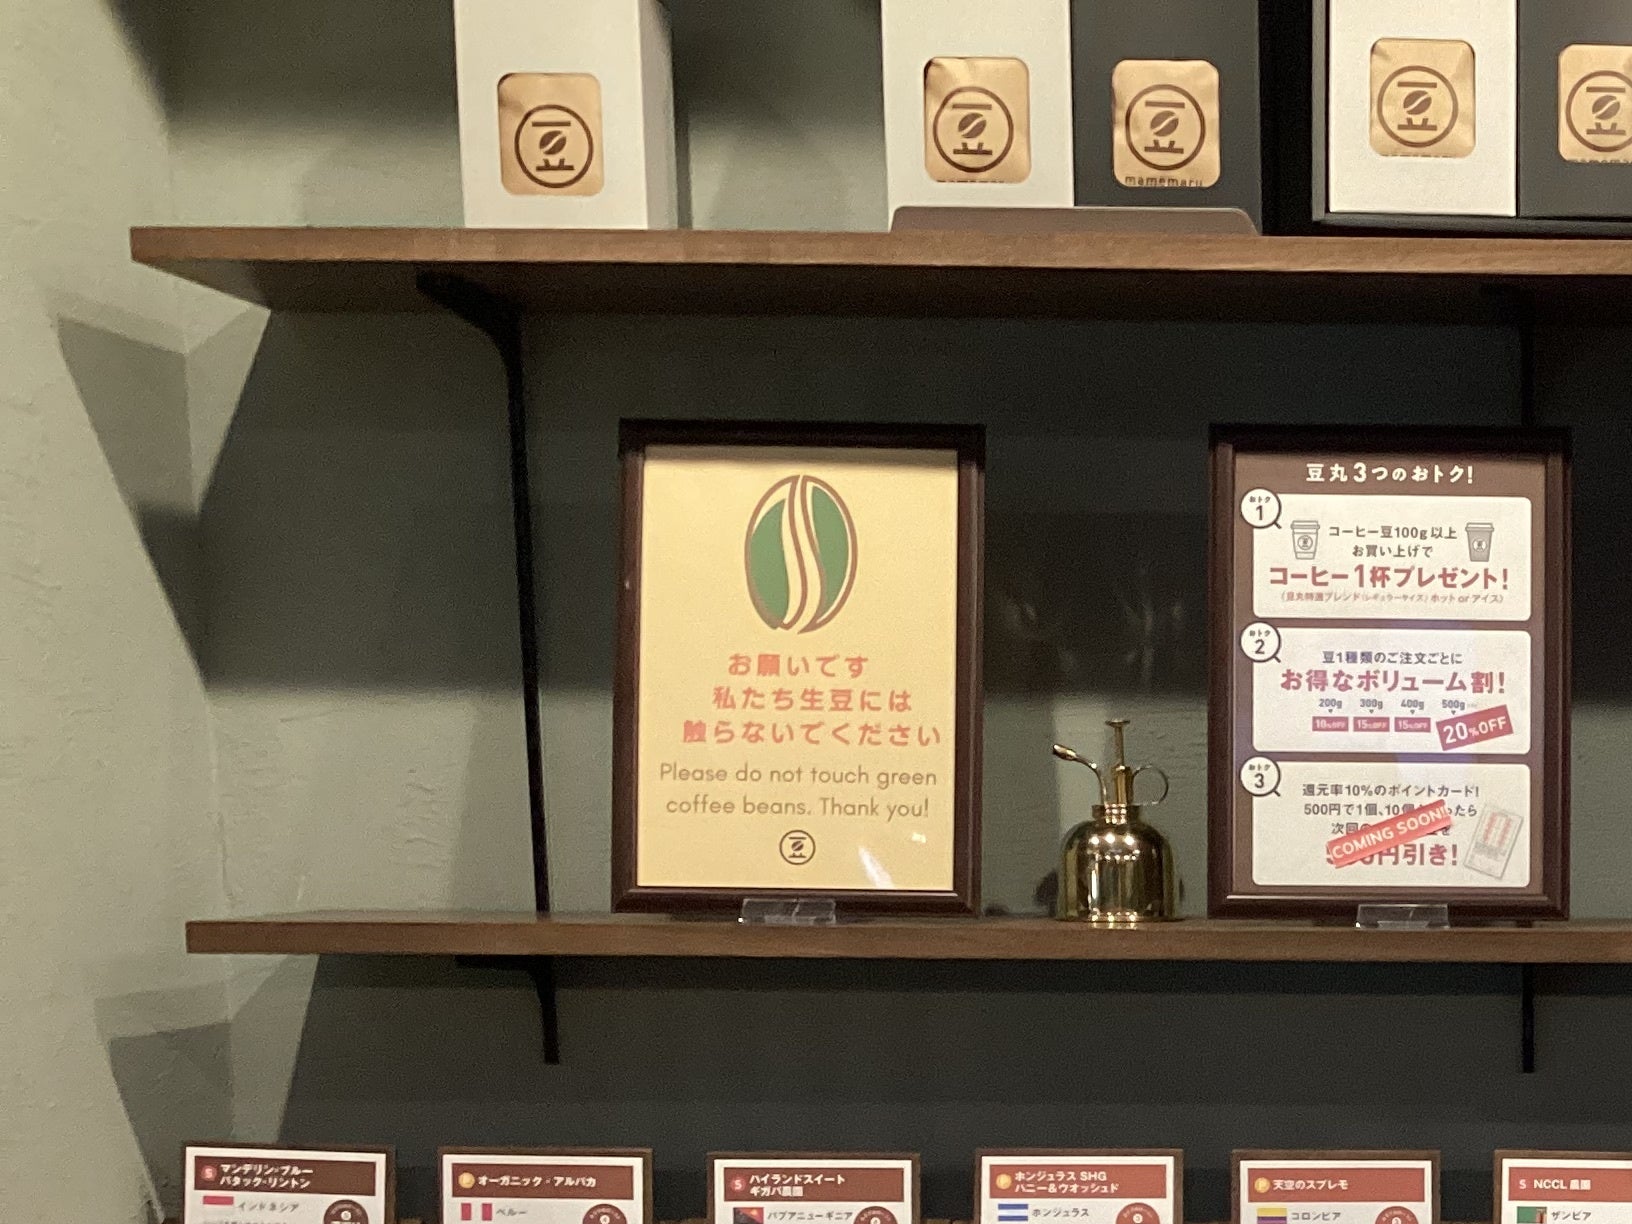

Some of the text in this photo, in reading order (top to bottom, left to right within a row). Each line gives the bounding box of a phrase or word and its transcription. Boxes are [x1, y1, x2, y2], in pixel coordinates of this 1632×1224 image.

[1306, 462, 1473, 484] 豆丸3つのおトク!
[1256, 505, 1264, 520] 1
[1329, 526, 1457, 540] コーヒー豆100g以上
[1352, 544, 1433, 558] お買い上げで
[1270, 565, 1508, 590] コーヒー1杯プレゼント!
[1255, 640, 1265, 655] 2
[1323, 651, 1462, 665] 豆1種類のご注文ごとに
[729, 654, 869, 679] お願いです
[1281, 670, 1504, 694] お得なボリューム割!
[713, 686, 912, 712] 私たち生豆には
[1319, 698, 1342, 709] 200g
[1401, 699, 1425, 710] 400g
[1442, 699, 1466, 711] 500g
[683, 720, 940, 746] 触らないでください
[1443, 715, 1507, 745] 20%OFF
[660, 763, 937, 790] Please do not touch green
[1255, 774, 1264, 789] 3
[666, 796, 928, 822] coffee beans. Thank you!
[1333, 827, 1393, 859] COMING
[749, 1174, 846, 1186] ハイランドスイート
[1015, 1170, 1107, 1182] ホンジュラス SHG
[1534, 1179, 1567, 1190] NCCL
[1032, 1208, 1090, 1219] ホンジュラス
[1291, 1210, 1341, 1221] コロンビア
[1551, 1210, 1592, 1221] ザンビア
